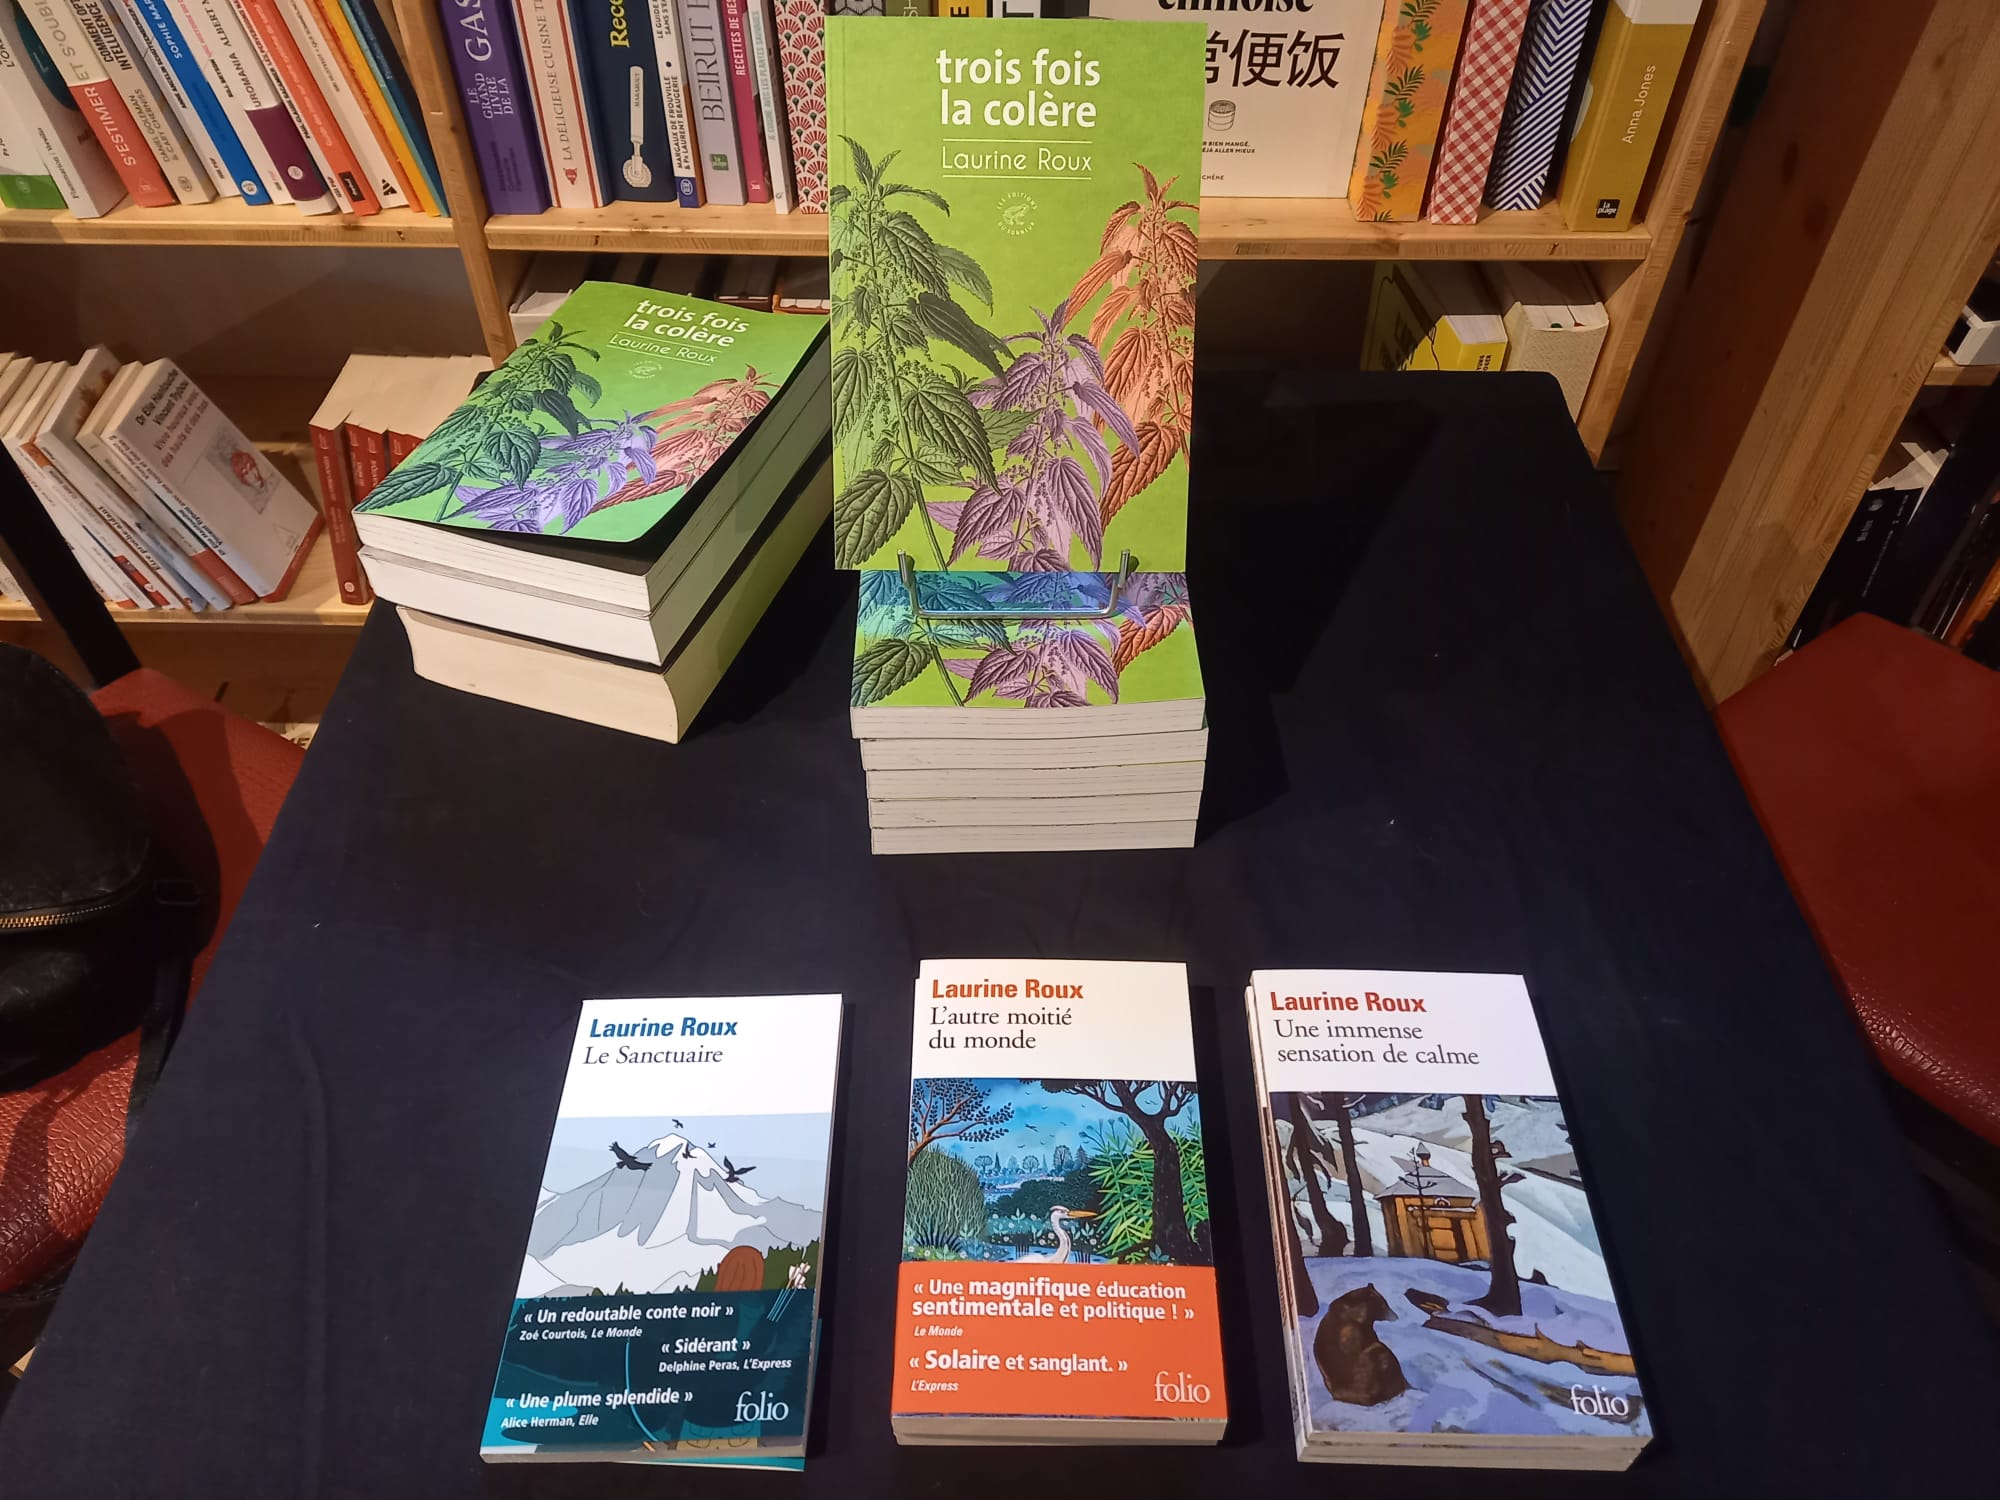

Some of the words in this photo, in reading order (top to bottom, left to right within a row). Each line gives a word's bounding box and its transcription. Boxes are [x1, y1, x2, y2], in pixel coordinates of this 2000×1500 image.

[205, 6, 231, 47] ALBERT
[653, 4, 662, 28] GUIDE
[662, 11, 671, 35] SANS
[729, 17, 740, 28] DE
[82, 19, 114, 63] COMMENT
[86, 1, 132, 70] INTELLIGENCE
[158, 23, 183, 59] SOPHIE
[536, 15, 556, 69] CUISINE
[658, 30, 664, 38] LE
[730, 32, 746, 76] RECETTES
[755, 48, 769, 75] PLANTES
[70, 64, 90, 81] ET
[689, 18, 725, 121] BEIRUT
[936, 48, 1021, 85] trois
[1032, 49, 1101, 87] fois
[467, 87, 479, 104] LE
[474, 73, 493, 119] GRAND
[486, 77, 503, 115] LIVRE
[497, 78, 510, 94] LA
[664, 76, 676, 119] FROUVILLE
[671, 76, 683, 118] BEAUGERIE
[129, 95, 154, 136] GOLEMAN
[135, 88, 161, 133] CHERNISS
[501, 97, 513, 115] DE
[548, 71, 569, 142] DÉLICIEUSE
[941, 89, 971, 126] la
[983, 90, 1097, 128] colère
[1622, 109, 1642, 144] Anna
[1634, 64, 1656, 106] Jones
[85, 86, 137, 166] S'ESTIMER
[671, 119, 677, 129] DE
[152, 136, 171, 162] DANIEL
[160, 133, 175, 154] CARY
[677, 119, 688, 155] LAURENT
[564, 146, 573, 160] LA
[671, 130, 683, 169] MARGAUX
[942, 147, 1027, 170] Laurine
[1038, 147, 1093, 172] Roux
[49, 155, 81, 200] Flammarion
[637, 300, 697, 322] trois
[700, 312, 750, 333] fois
[624, 314, 649, 331] la
[654, 324, 735, 347] colère
[609, 333, 671, 355] Laurine
[676, 346, 717, 363] Roux
[136, 415, 146, 426] Dr
[202, 524, 223, 546] Vincent
[931, 978, 1018, 999] Laurine
[1025, 979, 1084, 1000] Roux
[1270, 991, 1359, 1013] Laurine
[1365, 992, 1428, 1014] Roux
[589, 1016, 675, 1038] Laurine
[680, 1016, 738, 1038] Roux
[930, 1006, 1000, 1026] L'autre
[1007, 1007, 1073, 1026] moitié
[928, 1030, 956, 1049] du
[963, 1030, 1037, 1049] monde
[1274, 1019, 1320, 1039] Une
[1326, 1019, 1423, 1040] immense
[583, 1046, 610, 1065] Le
[615, 1045, 723, 1064] Sanctuaire
[1277, 1044, 1375, 1064] sensation
[1382, 1044, 1409, 1064] de
[1415, 1046, 1480, 1065] calme
[928, 1279, 964, 1296] Une
[968, 1278, 1092, 1301] magnifique
[1096, 1281, 1187, 1299] éducation
[537, 1308, 557, 1324] Un
[560, 1305, 642, 1323] redoutable
[646, 1306, 687, 1320] conte
[691, 1303, 722, 1319] noir
[912, 1299, 1055, 1318] sentimentale
[1059, 1301, 1079, 1317] et
[1083, 1301, 1166, 1321] politique
[1171, 1303, 1177, 1320] !
[519, 1326, 541, 1341] Zoé
[542, 1326, 588, 1341] Courtois,
[590, 1326, 606, 1339] Le
[607, 1325, 643, 1339] Monde
[914, 1325, 927, 1337] Le
[929, 1325, 964, 1337] Monde
[674, 1336, 738, 1354] Sidérant
[658, 1359, 706, 1374] Delphine
[708, 1359, 740, 1373] Peras,
[743, 1356, 792, 1372] L'Express
[924, 1350, 1001, 1370] Solaire
[1005, 1355, 1025, 1370] et
[1028, 1353, 1113, 1374] sanglant.
[911, 1379, 959, 1392] L'Express
[1154, 1371, 1211, 1404] folio
[519, 1392, 551, 1409] Une
[553, 1392, 601, 1412] plume
[605, 1388, 680, 1409] splendide
[733, 1391, 790, 1423] folio
[1570, 1384, 1629, 1417] folio
[501, 1414, 528, 1429] Alice
[530, 1412, 575, 1429] Herman,
[578, 1412, 599, 1426] Elle
